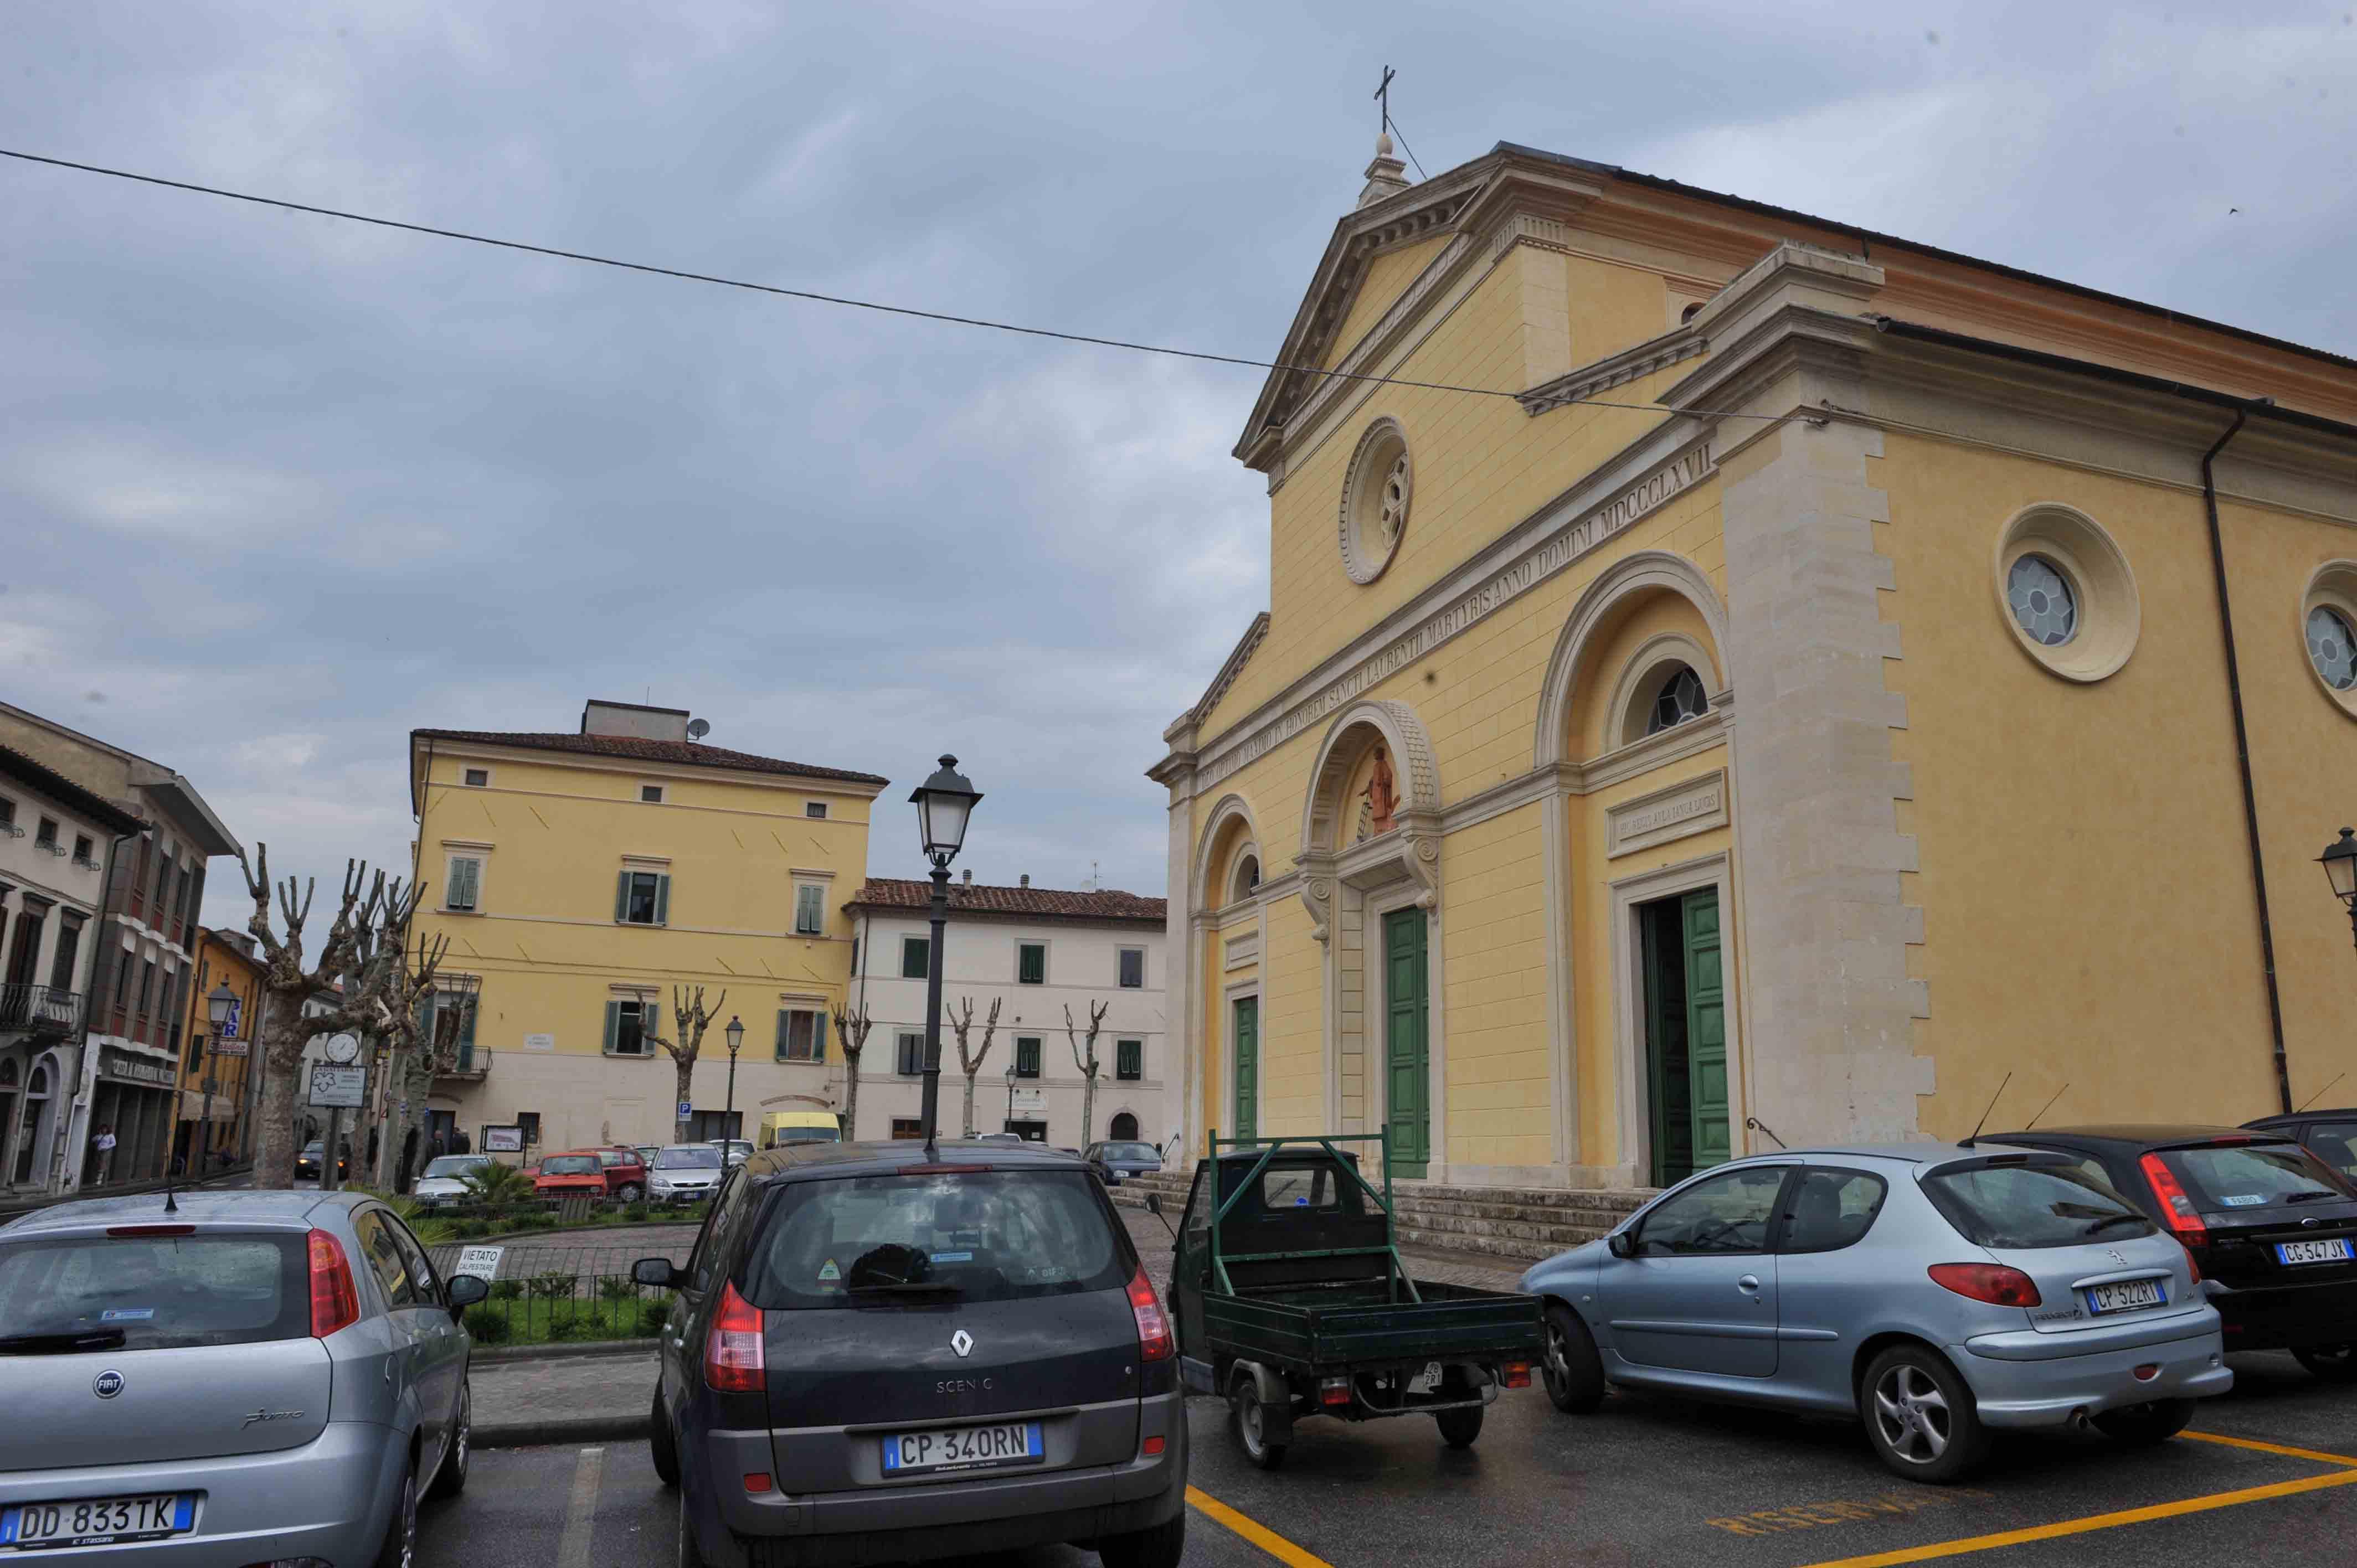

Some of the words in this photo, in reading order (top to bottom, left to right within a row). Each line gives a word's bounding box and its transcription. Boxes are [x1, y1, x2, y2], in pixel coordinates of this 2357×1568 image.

[1274, 726, 1282, 745] IN
[1286, 695, 1325, 736] HONOREM
[1330, 672, 1362, 709] SANCTI
[1367, 631, 1423, 685] LAURENTII
[1427, 588, 1490, 647] MARTYRIS
[1494, 562, 1531, 605] ANNO
[1538, 521, 1592, 577] DOMINI
[1599, 443, 1710, 538] MDCCCLXVII
[682, 1104, 688, 1112] P
[464, 1250, 497, 1262] VIETATO
[2286, 1244, 2303, 1261] CG
[2095, 1287, 2112, 1308] CP
[98, 1379, 119, 1389] FIAT
[936, 1378, 993, 1394] SCENC
[901, 1435, 933, 1464] CP
[943, 1426, 1025, 1460] 340RN
[20, 1506, 60, 1539] DD
[72, 1497, 173, 1534] 833TK
